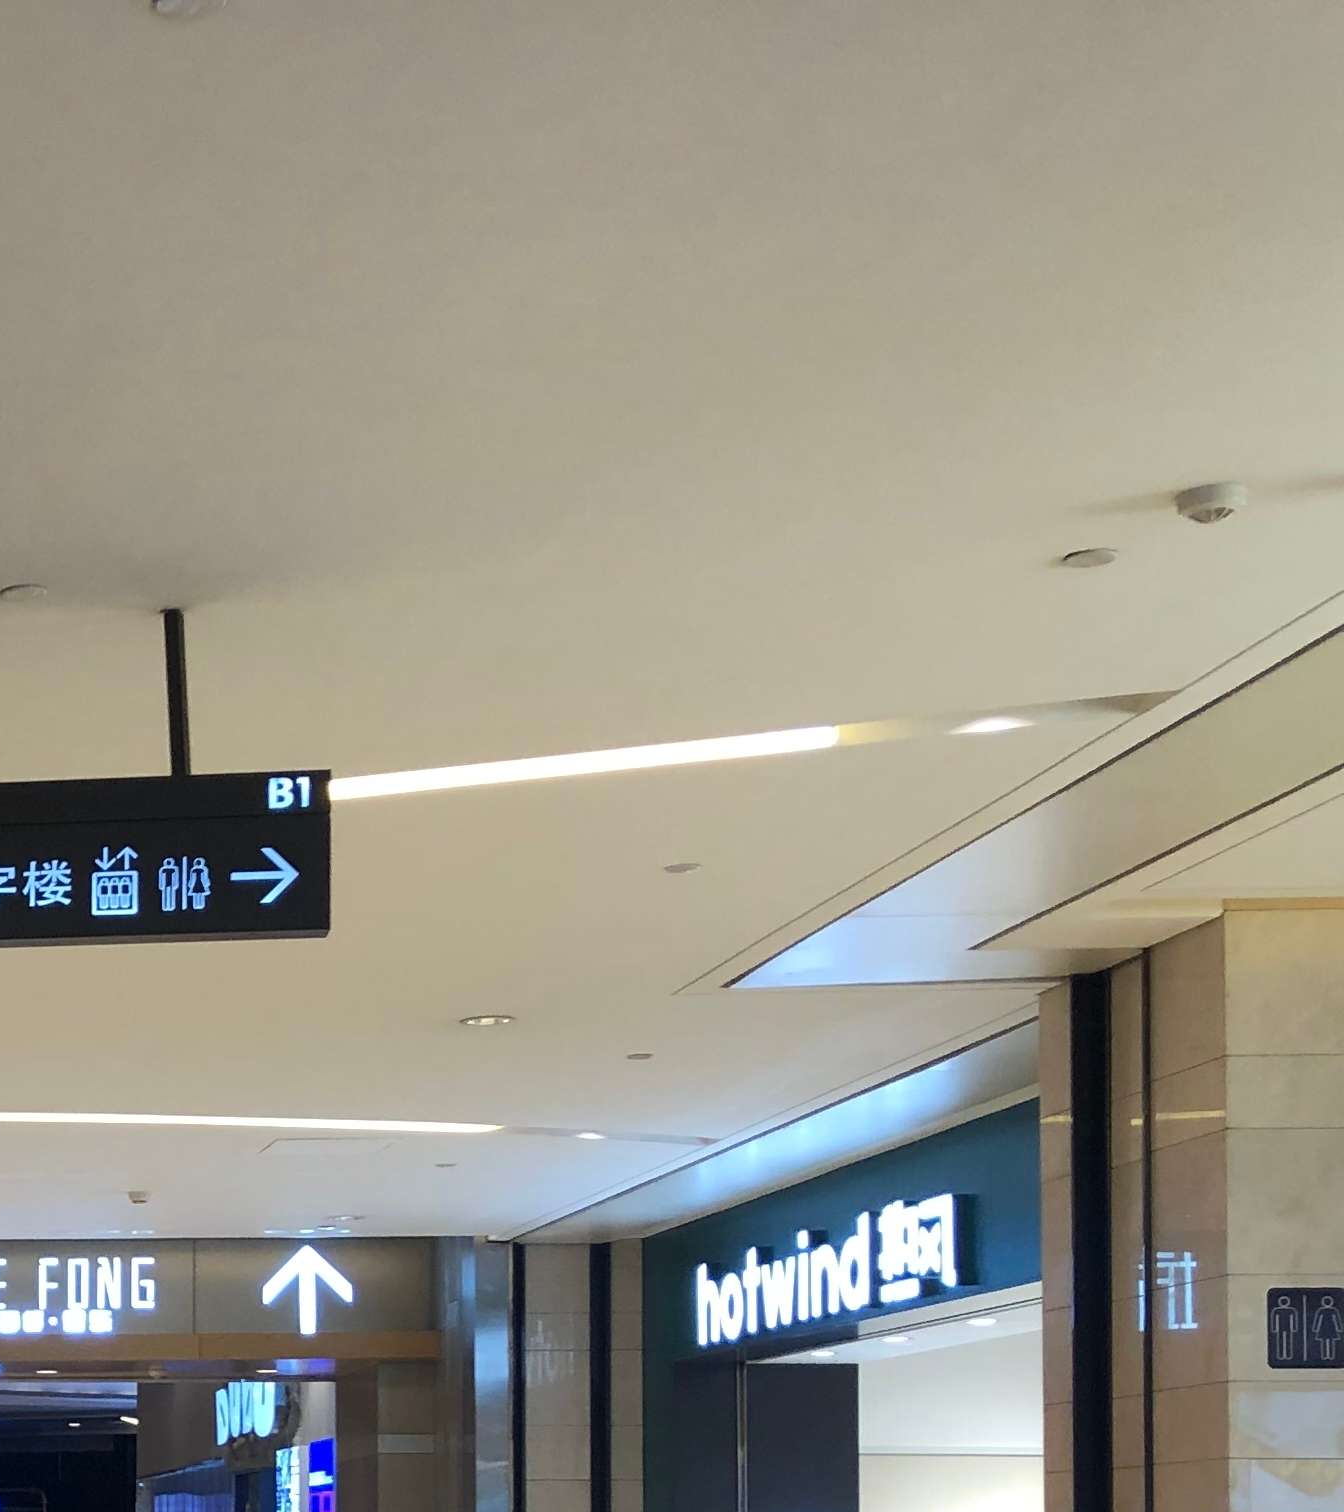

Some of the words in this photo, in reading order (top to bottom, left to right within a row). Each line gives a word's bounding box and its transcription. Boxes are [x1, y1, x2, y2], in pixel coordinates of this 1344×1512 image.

[267, 775, 312, 810] B1
[37, 1255, 157, 1311] FONG
[696, 1210, 871, 1347] hotwind
